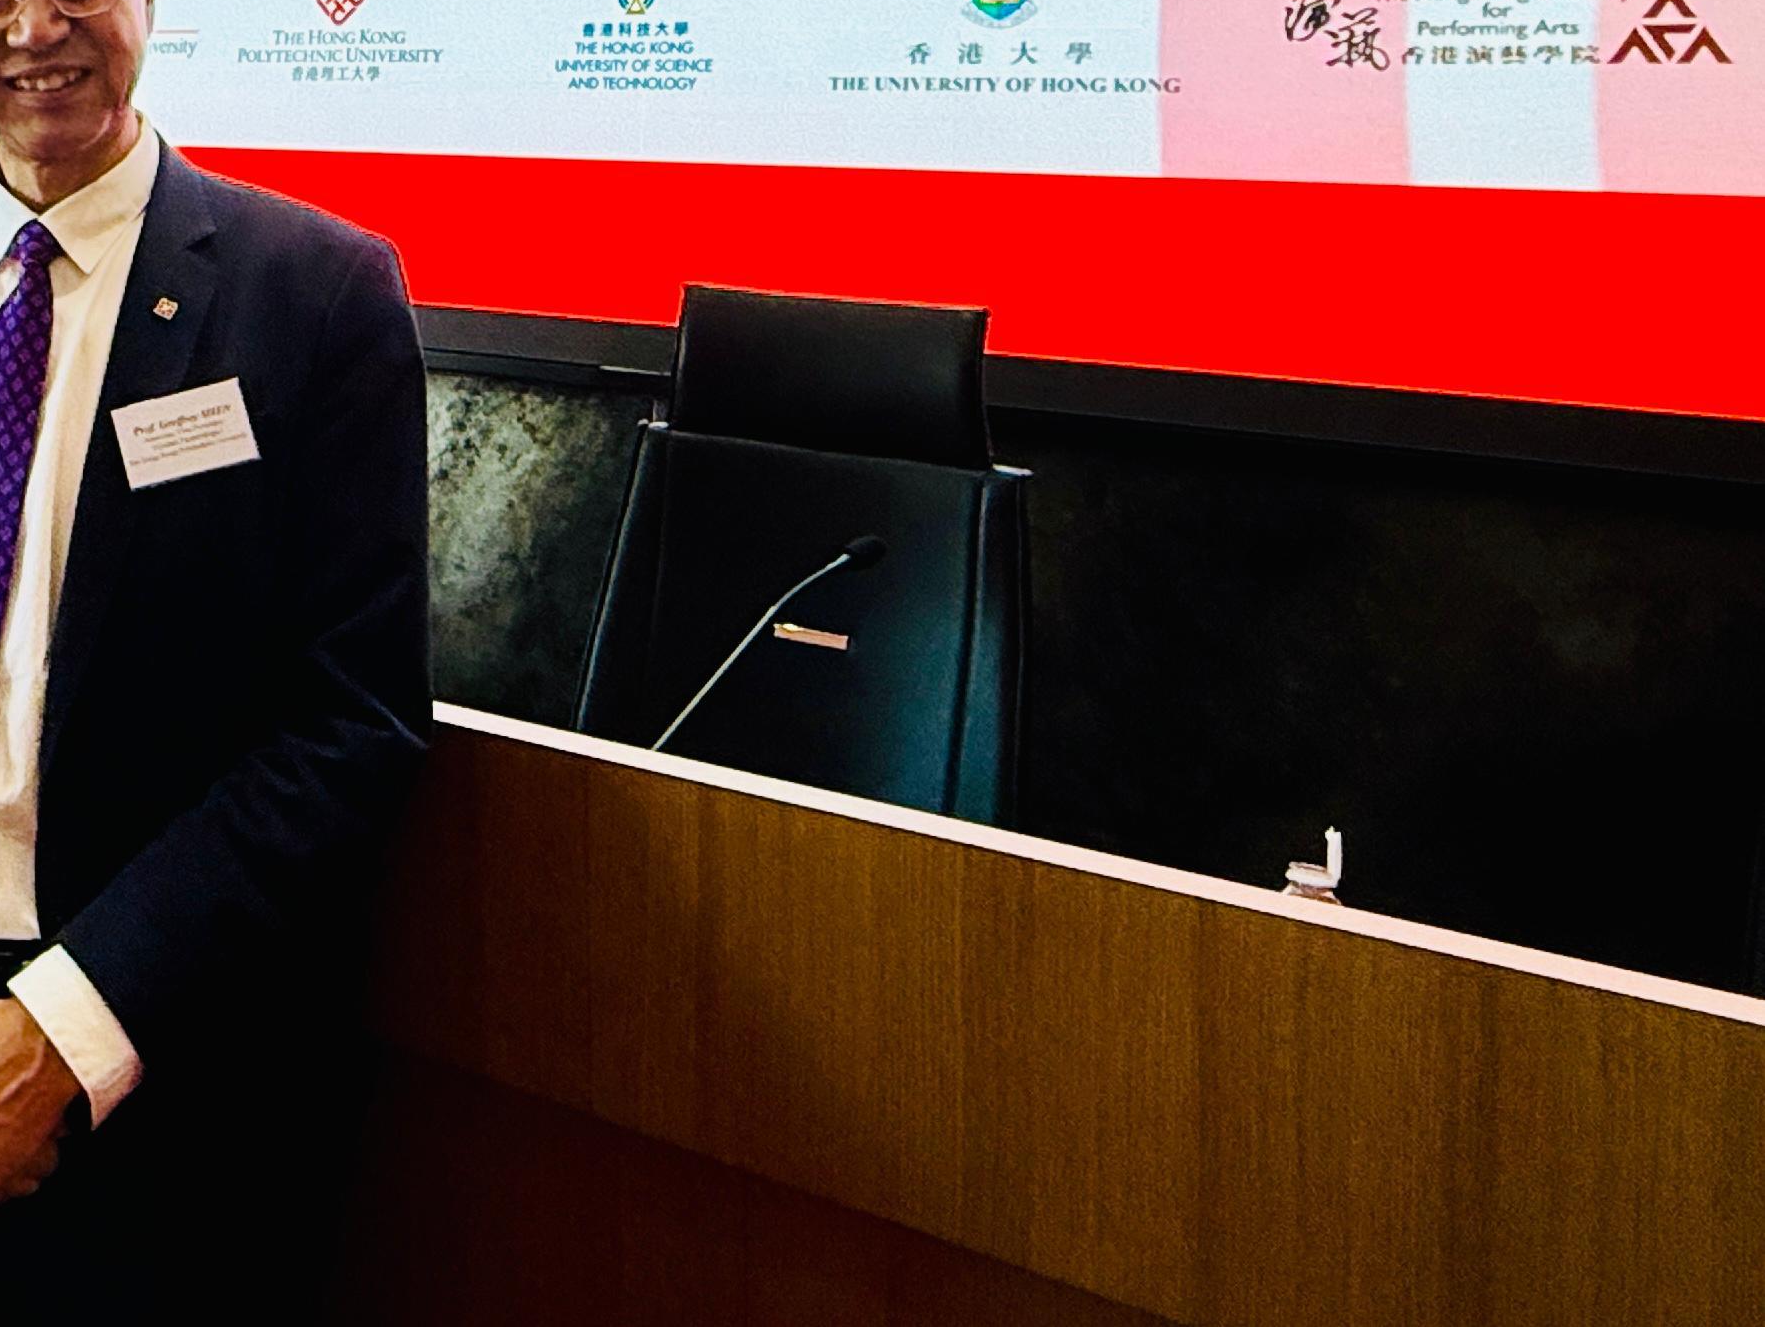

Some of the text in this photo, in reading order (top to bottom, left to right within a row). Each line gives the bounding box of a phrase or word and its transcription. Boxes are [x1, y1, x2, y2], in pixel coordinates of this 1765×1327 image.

[1482, 3, 1514, 18] for
[1417, 20, 1580, 40] Performing Arts
[237, 47, 444, 63] POLYTECHNIC UNIVERSITY
[575, 40, 694, 55] THE HONG KONG
[906, 40, 1093, 66] 香港大學
[555, 58, 713, 73] UNIVERSITY OF SCIENCE
[568, 76, 697, 91] AND TECHNOLOGY
[828, 76, 1181, 94] THE UNIVERSITY OF HONG KONG
